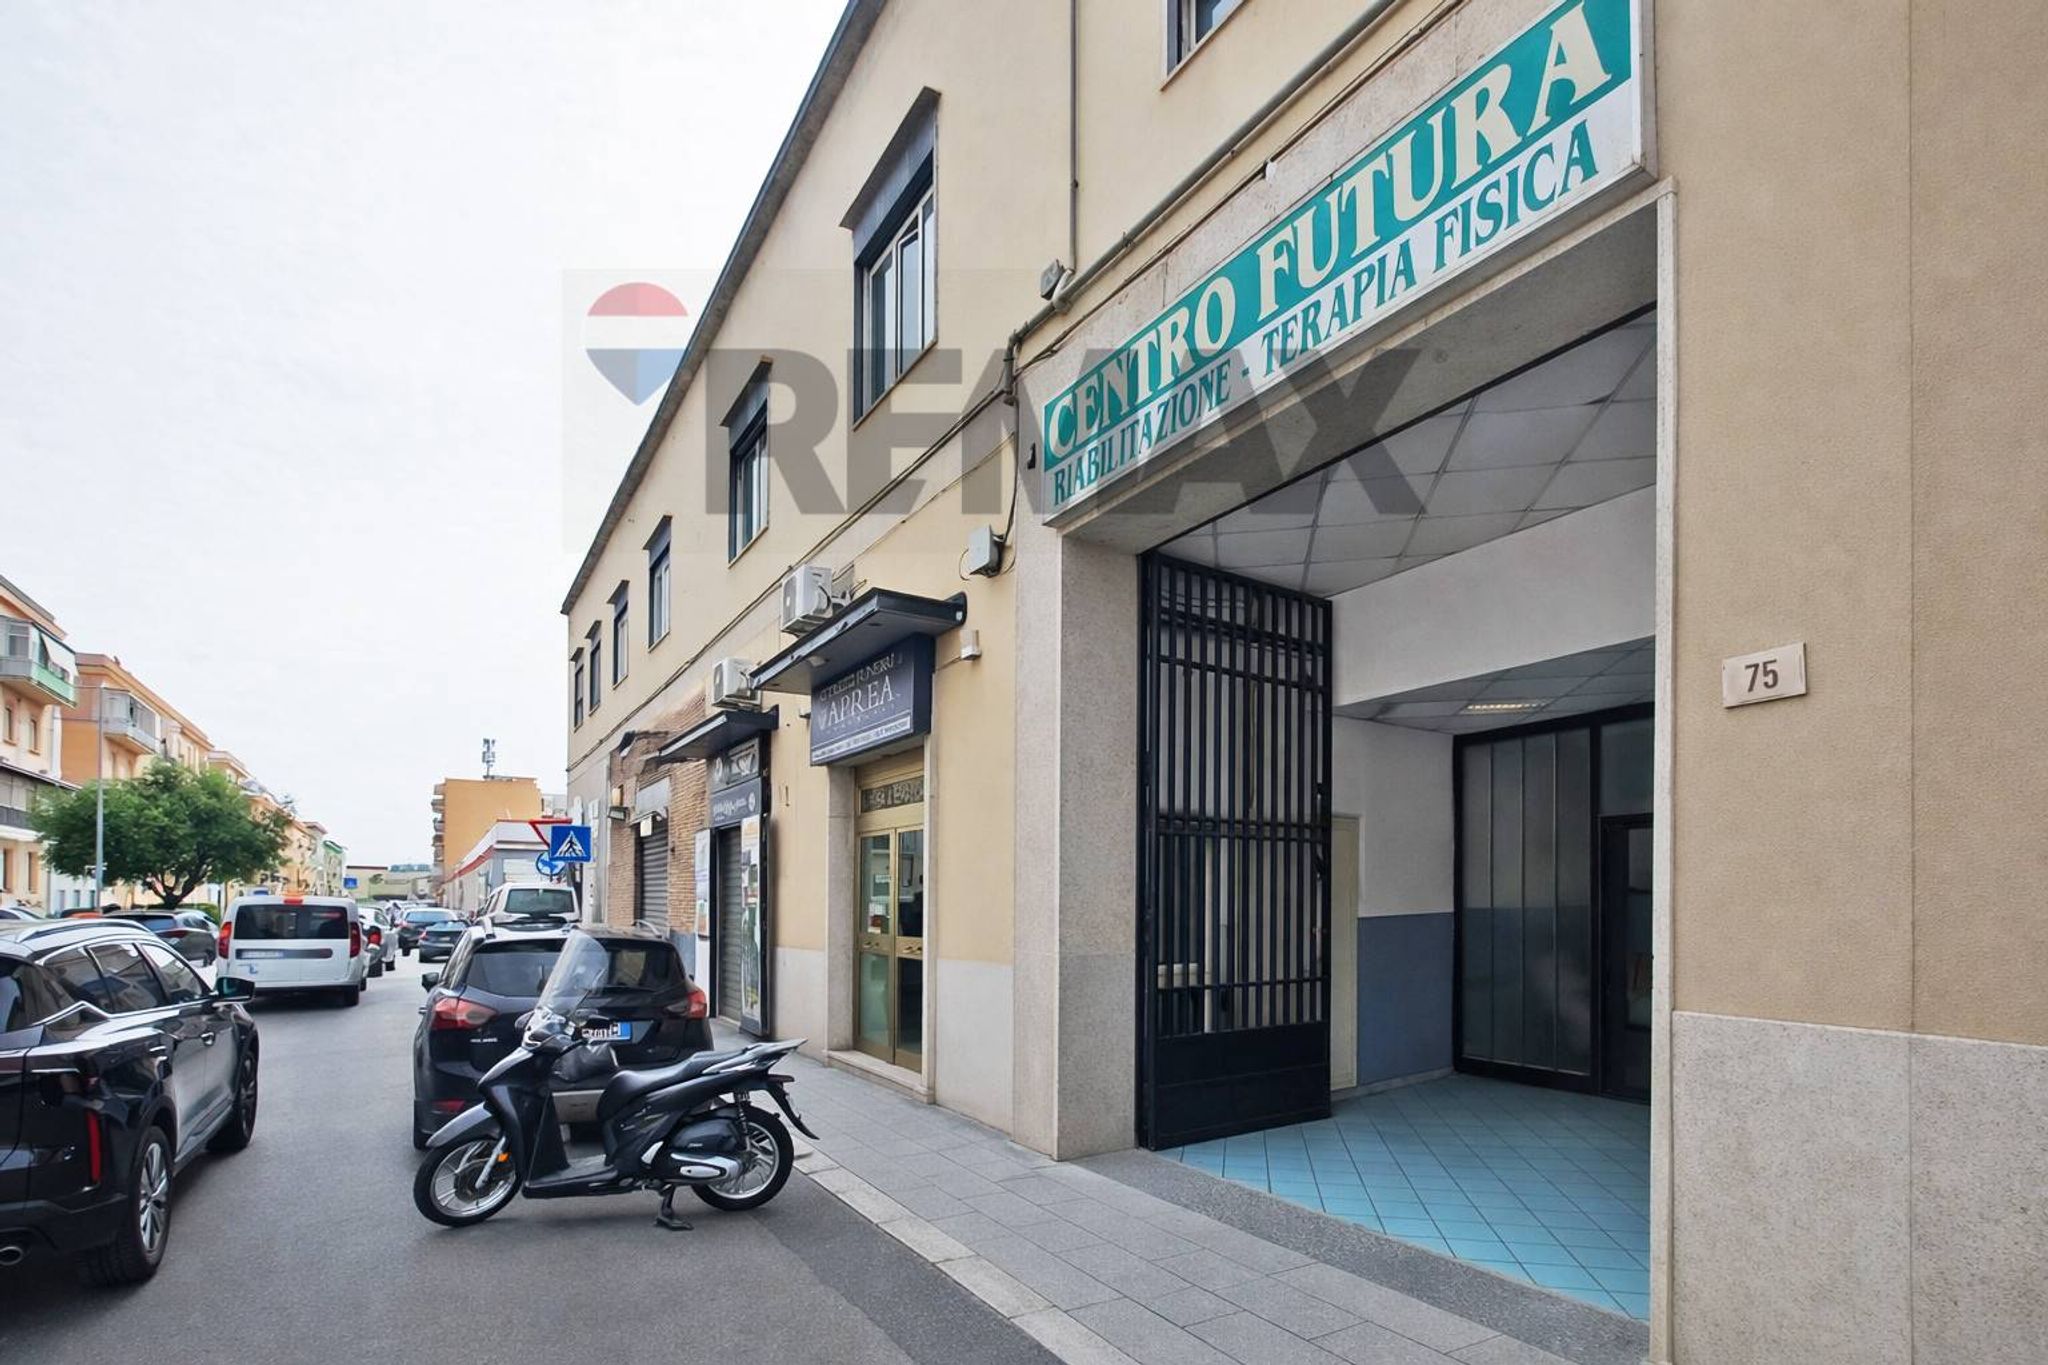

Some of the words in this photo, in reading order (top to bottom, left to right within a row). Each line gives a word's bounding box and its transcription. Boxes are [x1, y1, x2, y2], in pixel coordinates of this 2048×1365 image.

[1049, 276, 1236, 458] CENTRO
[1256, 1, 1612, 322] FUTURA
[1053, 359, 1232, 506] RIABILITAZIONE
[1261, 238, 1417, 378] TERAPIA
[1433, 118, 1599, 273] FISICA
[827, 674, 895, 727] APREA
[1744, 658, 1779, 693] 75
